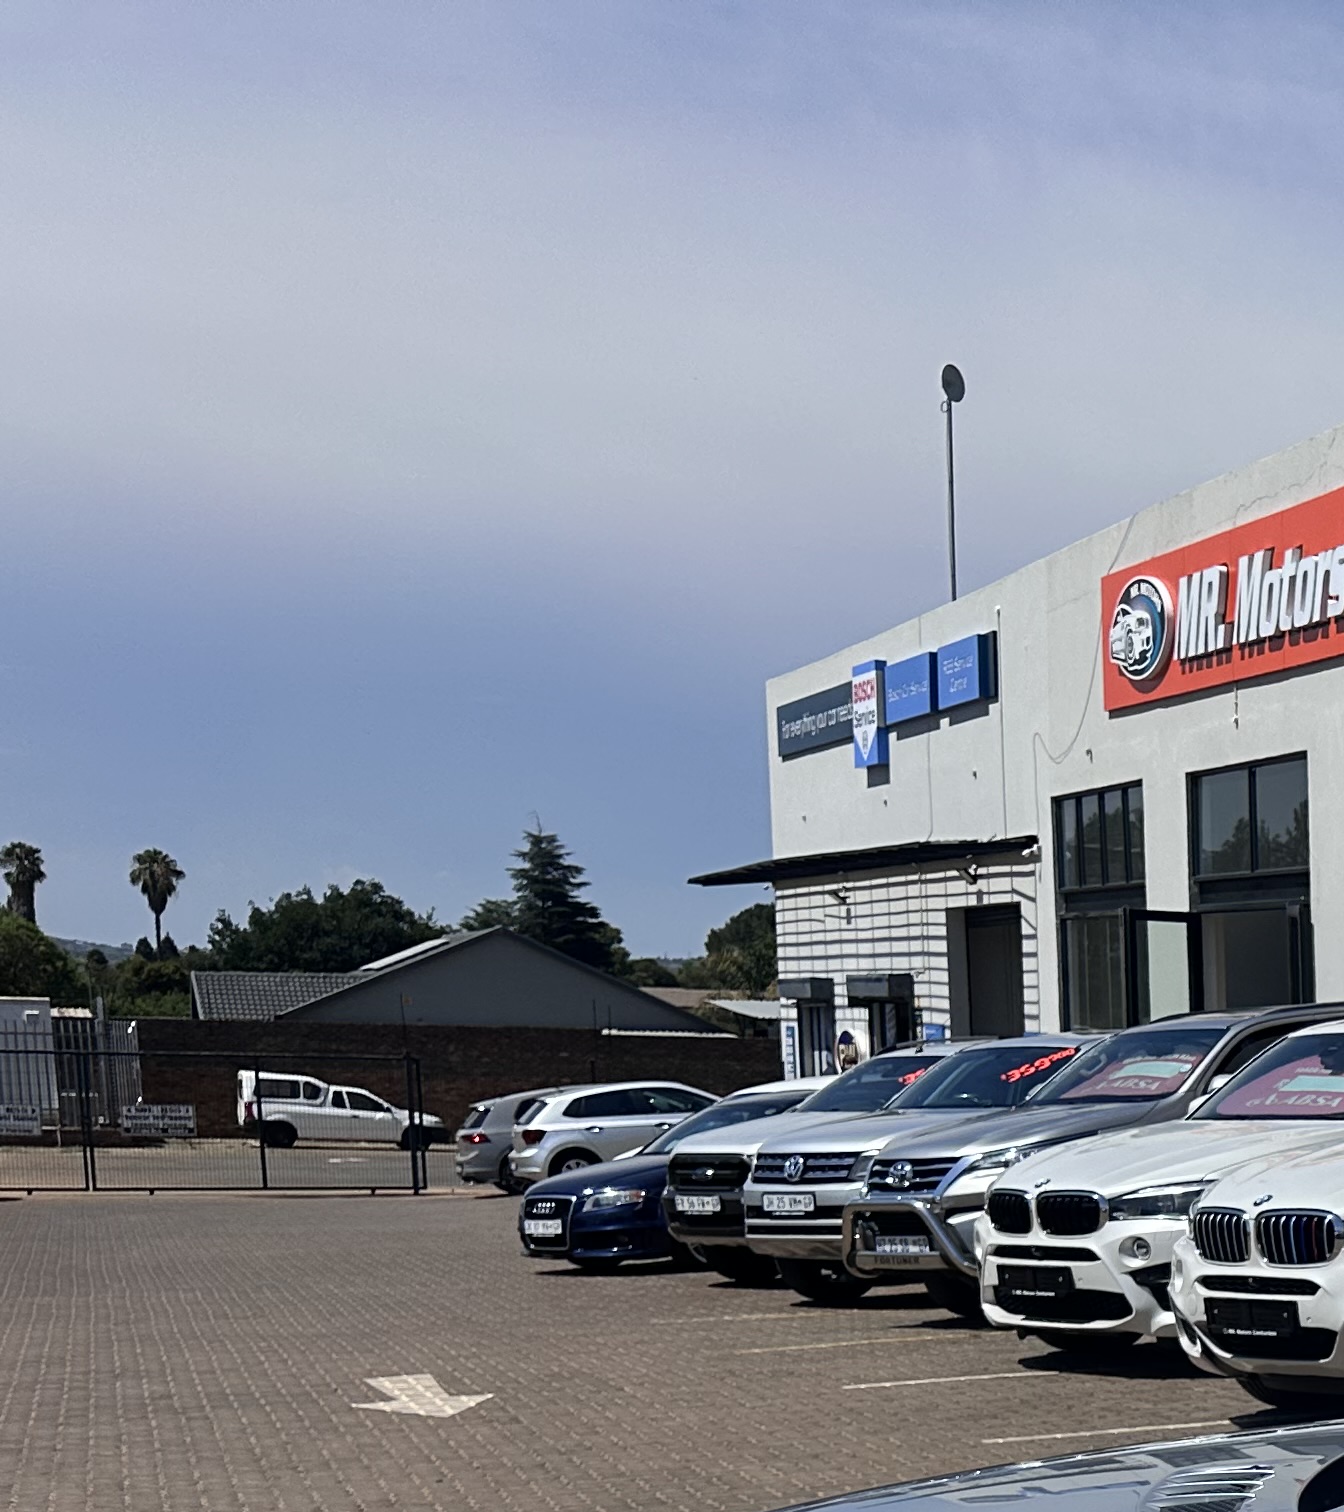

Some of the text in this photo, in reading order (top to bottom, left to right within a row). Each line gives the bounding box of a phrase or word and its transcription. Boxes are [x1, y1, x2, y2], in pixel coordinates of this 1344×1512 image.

[1174, 565, 1230, 660] MR.
[853, 678, 876, 704] BOSCH
[854, 707, 876, 728] Service
